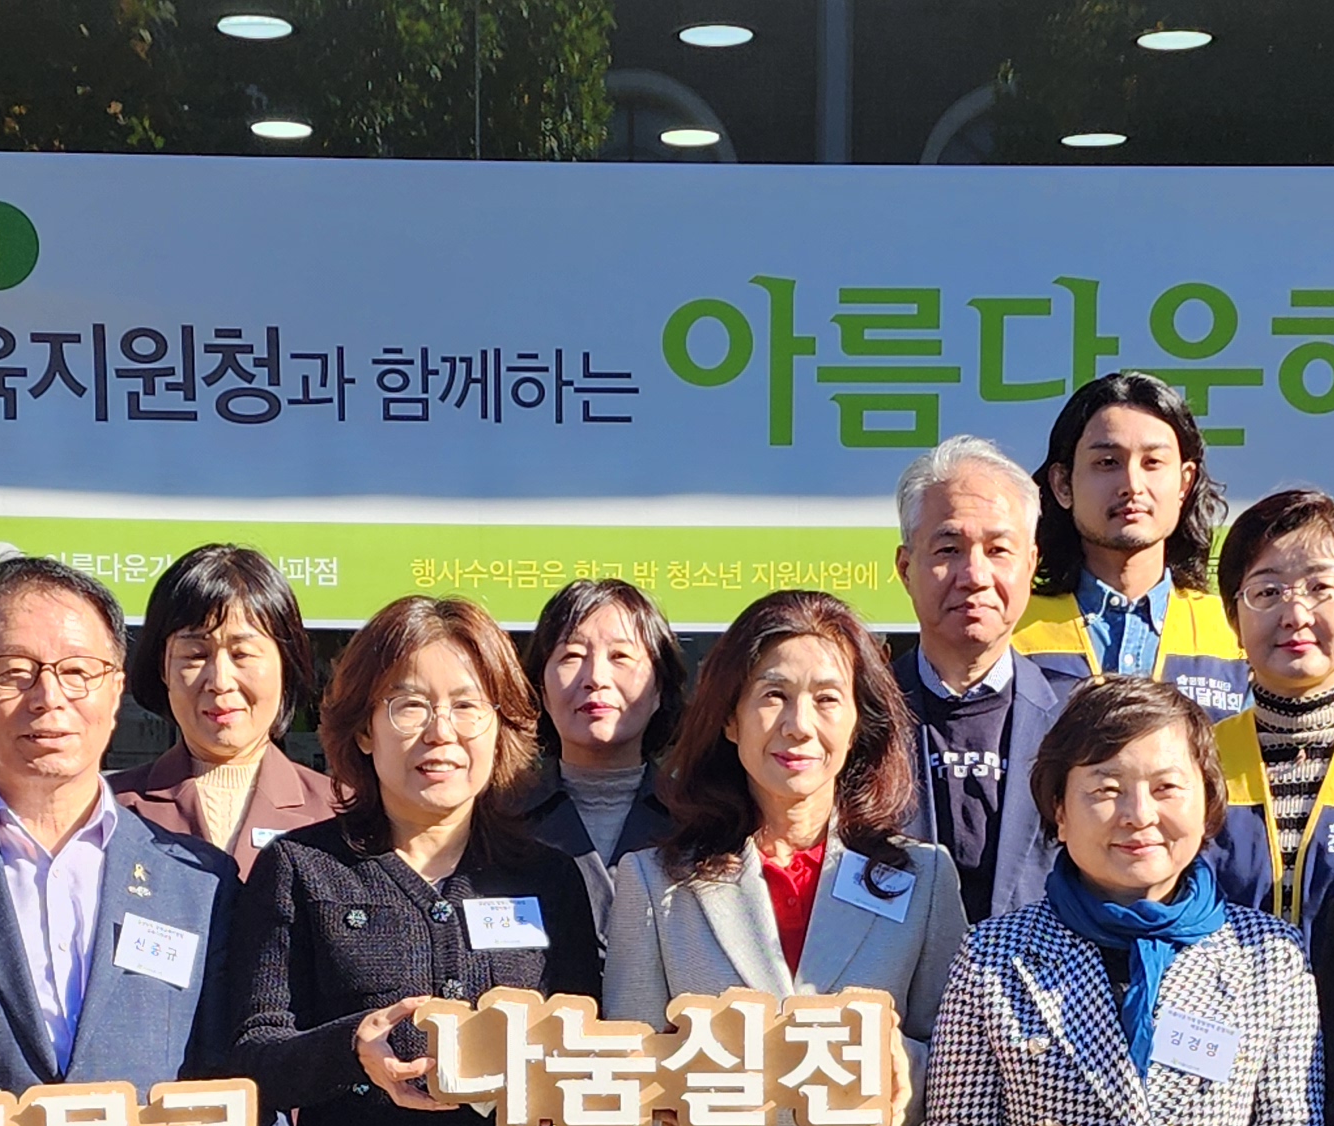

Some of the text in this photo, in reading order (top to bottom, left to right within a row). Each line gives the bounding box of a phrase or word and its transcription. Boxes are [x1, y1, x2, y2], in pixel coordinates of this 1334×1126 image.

[371, 346, 641, 425] 함께하는
[410, 558, 567, 590] 행사수익금은
[633, 560, 659, 589] 밖
[667, 560, 742, 591] 청소년
[752, 560, 879, 592] 지원사업에
[426, 1000, 883, 1126] 나눔실천
